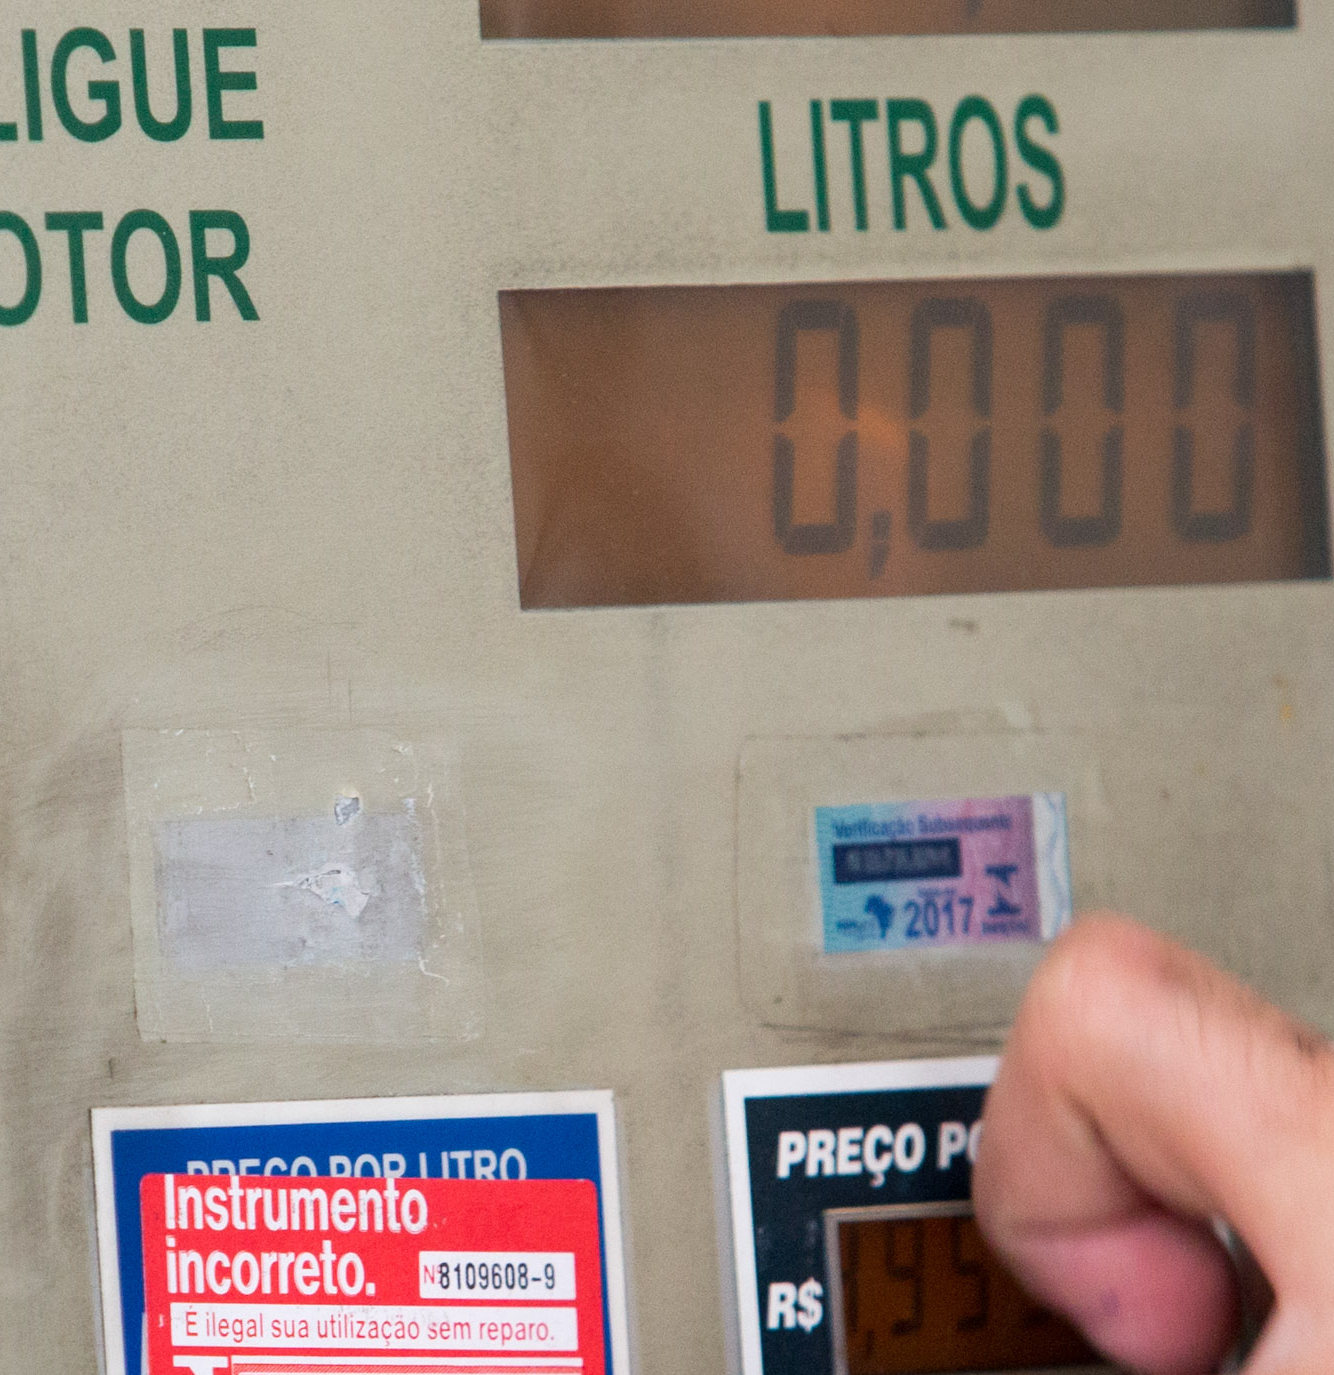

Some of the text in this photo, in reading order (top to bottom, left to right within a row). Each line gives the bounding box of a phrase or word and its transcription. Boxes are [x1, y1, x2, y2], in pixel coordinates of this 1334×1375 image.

[757, 93, 1067, 233] LITROS
[771, 292, 1259, 583] 0,000
[903, 897, 975, 939] 2017
[776, 1122, 927, 1188] PREÇO
[164, 1173, 429, 1234] Instrumento
[165, 1235, 377, 1297] incorreto.
[184, 1310, 556, 1346] É ilegal sua utilização sem reparo.
[768, 1278, 824, 1332] R$
